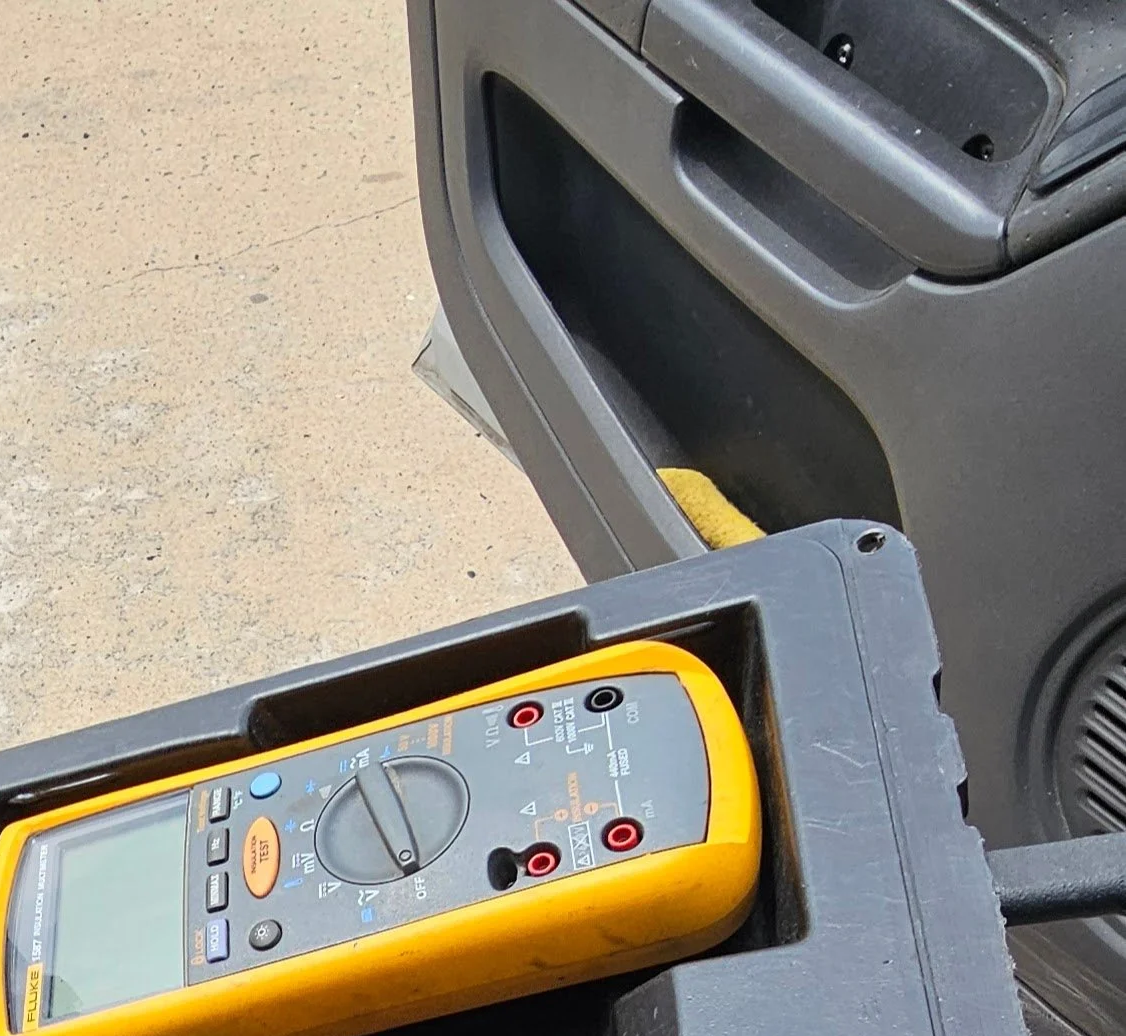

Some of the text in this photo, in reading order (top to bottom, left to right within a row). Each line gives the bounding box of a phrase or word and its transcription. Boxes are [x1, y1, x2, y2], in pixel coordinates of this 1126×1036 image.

[554, 710, 564, 725] CAT
[565, 708, 575, 723] CAT
[626, 702, 639, 724] COM
[356, 748, 370, 768] mA
[618, 748, 630, 776] FUSED
[212, 787, 223, 813] RANGE
[641, 800, 655, 819] mA
[259, 840, 269, 863] TEST
[301, 852, 315, 874] mV
[414, 877, 426, 899] OFF
[34, 893, 44, 936] INSULATION
[210, 926, 219, 952] HOLD
[32, 940, 42, 962] 1587
[27, 970, 39, 1023] FLUKE
